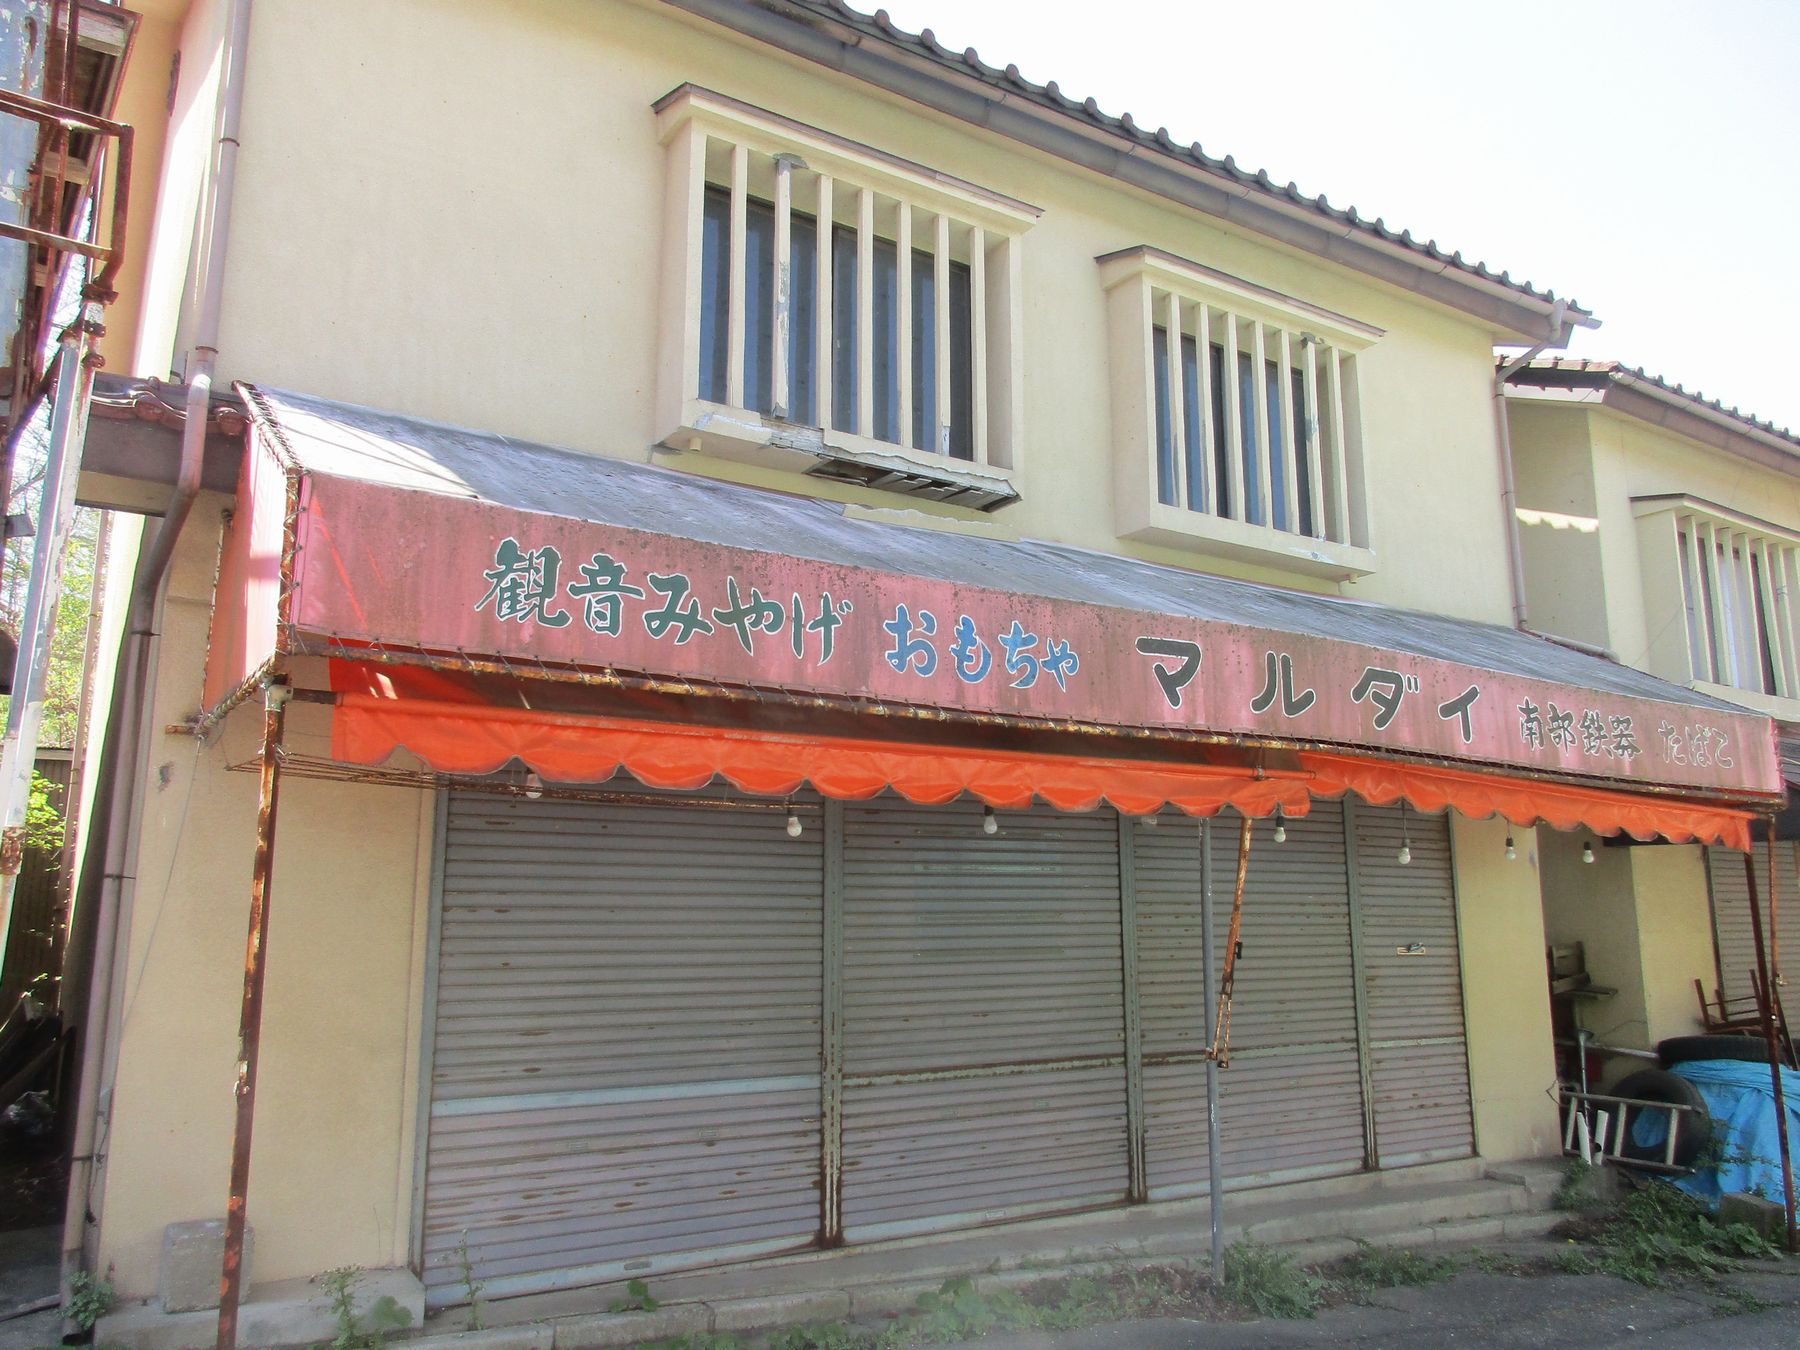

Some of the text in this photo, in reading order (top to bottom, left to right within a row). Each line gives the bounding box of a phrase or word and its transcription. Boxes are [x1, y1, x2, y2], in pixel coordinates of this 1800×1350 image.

[474, 537, 1734, 768] 観音みやげ おもちゃ マルダイ 南部鉄器 たばこ
